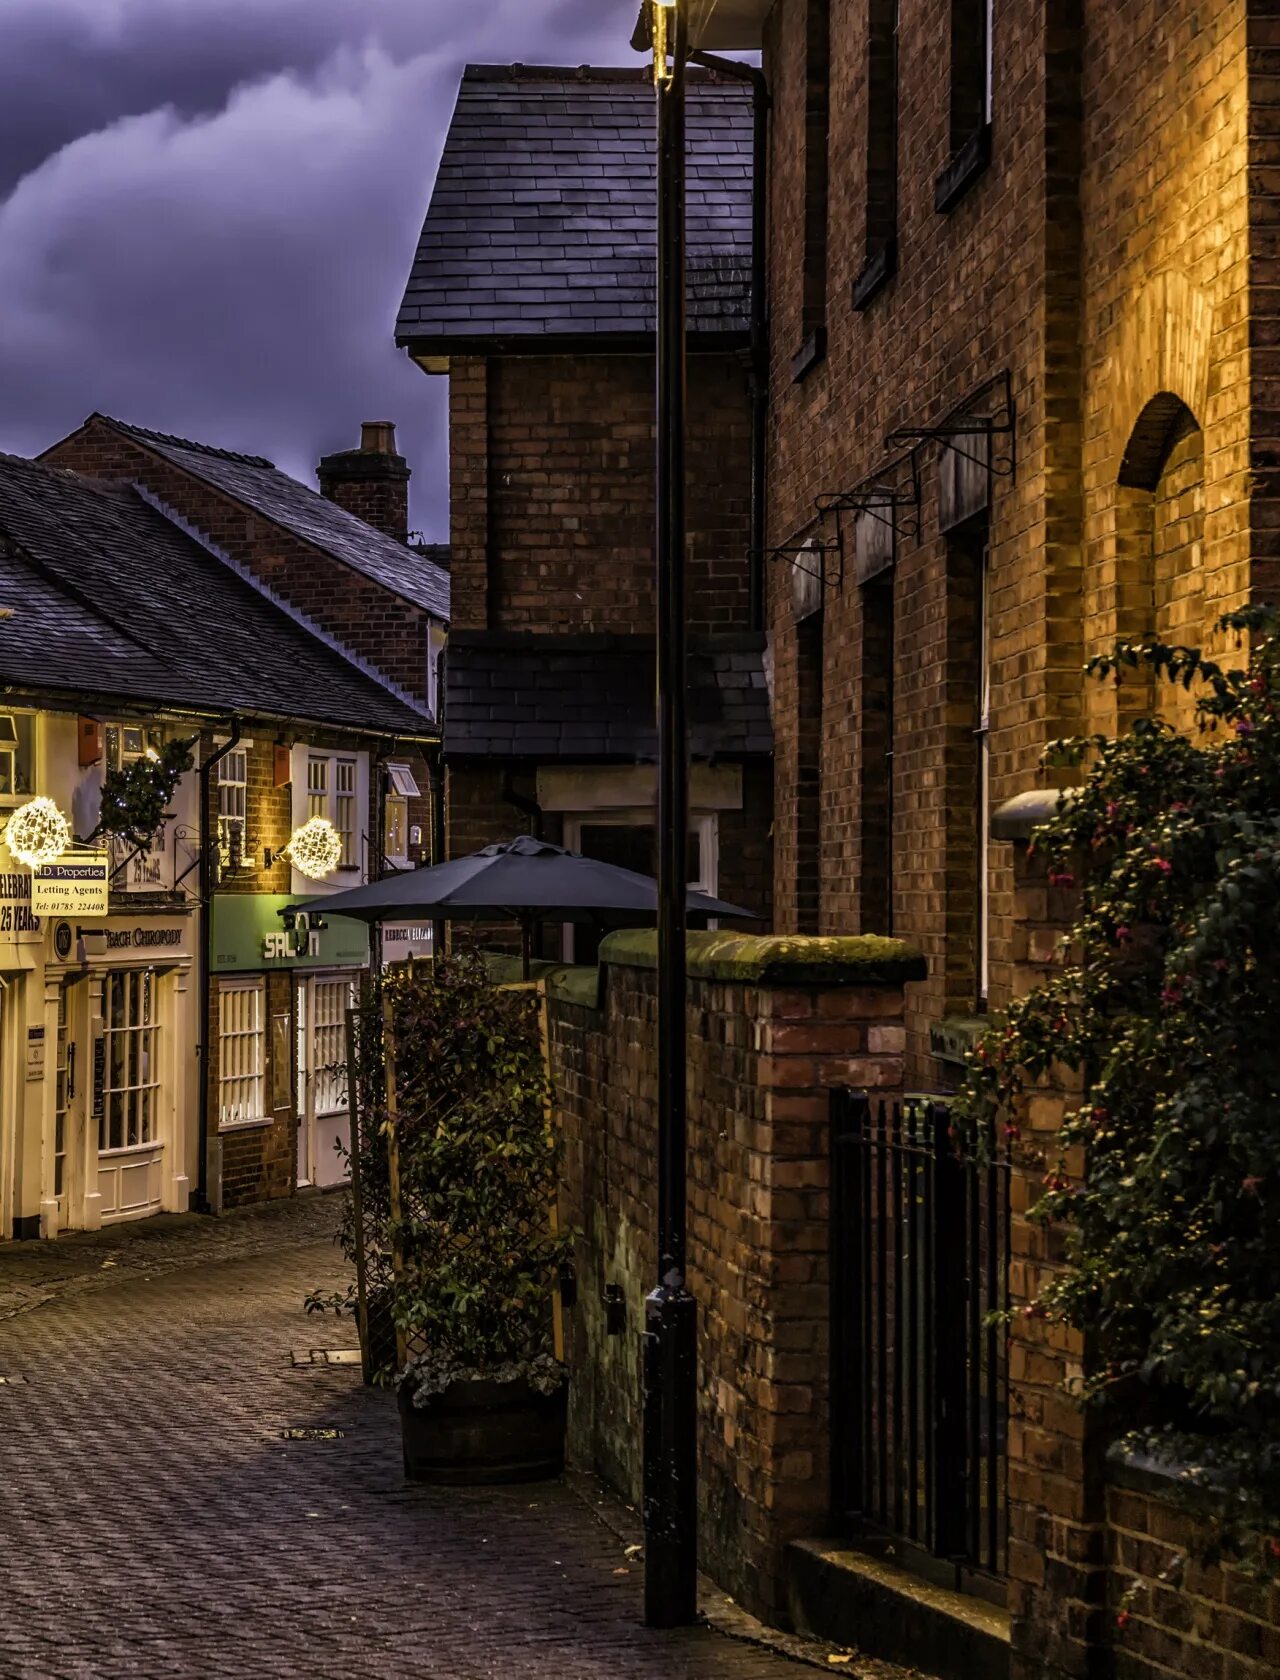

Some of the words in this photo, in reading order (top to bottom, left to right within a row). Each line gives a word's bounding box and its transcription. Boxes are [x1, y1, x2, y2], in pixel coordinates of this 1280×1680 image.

[57, 866, 105, 879] Properties
[37, 885, 70, 896] Letting
[72, 886, 103, 896] Agents
[36, 902, 49, 910] Tel:
[51, 902, 74, 910] 01785
[1, 905, 12, 931] 25
[13, 905, 40, 931] YEARS
